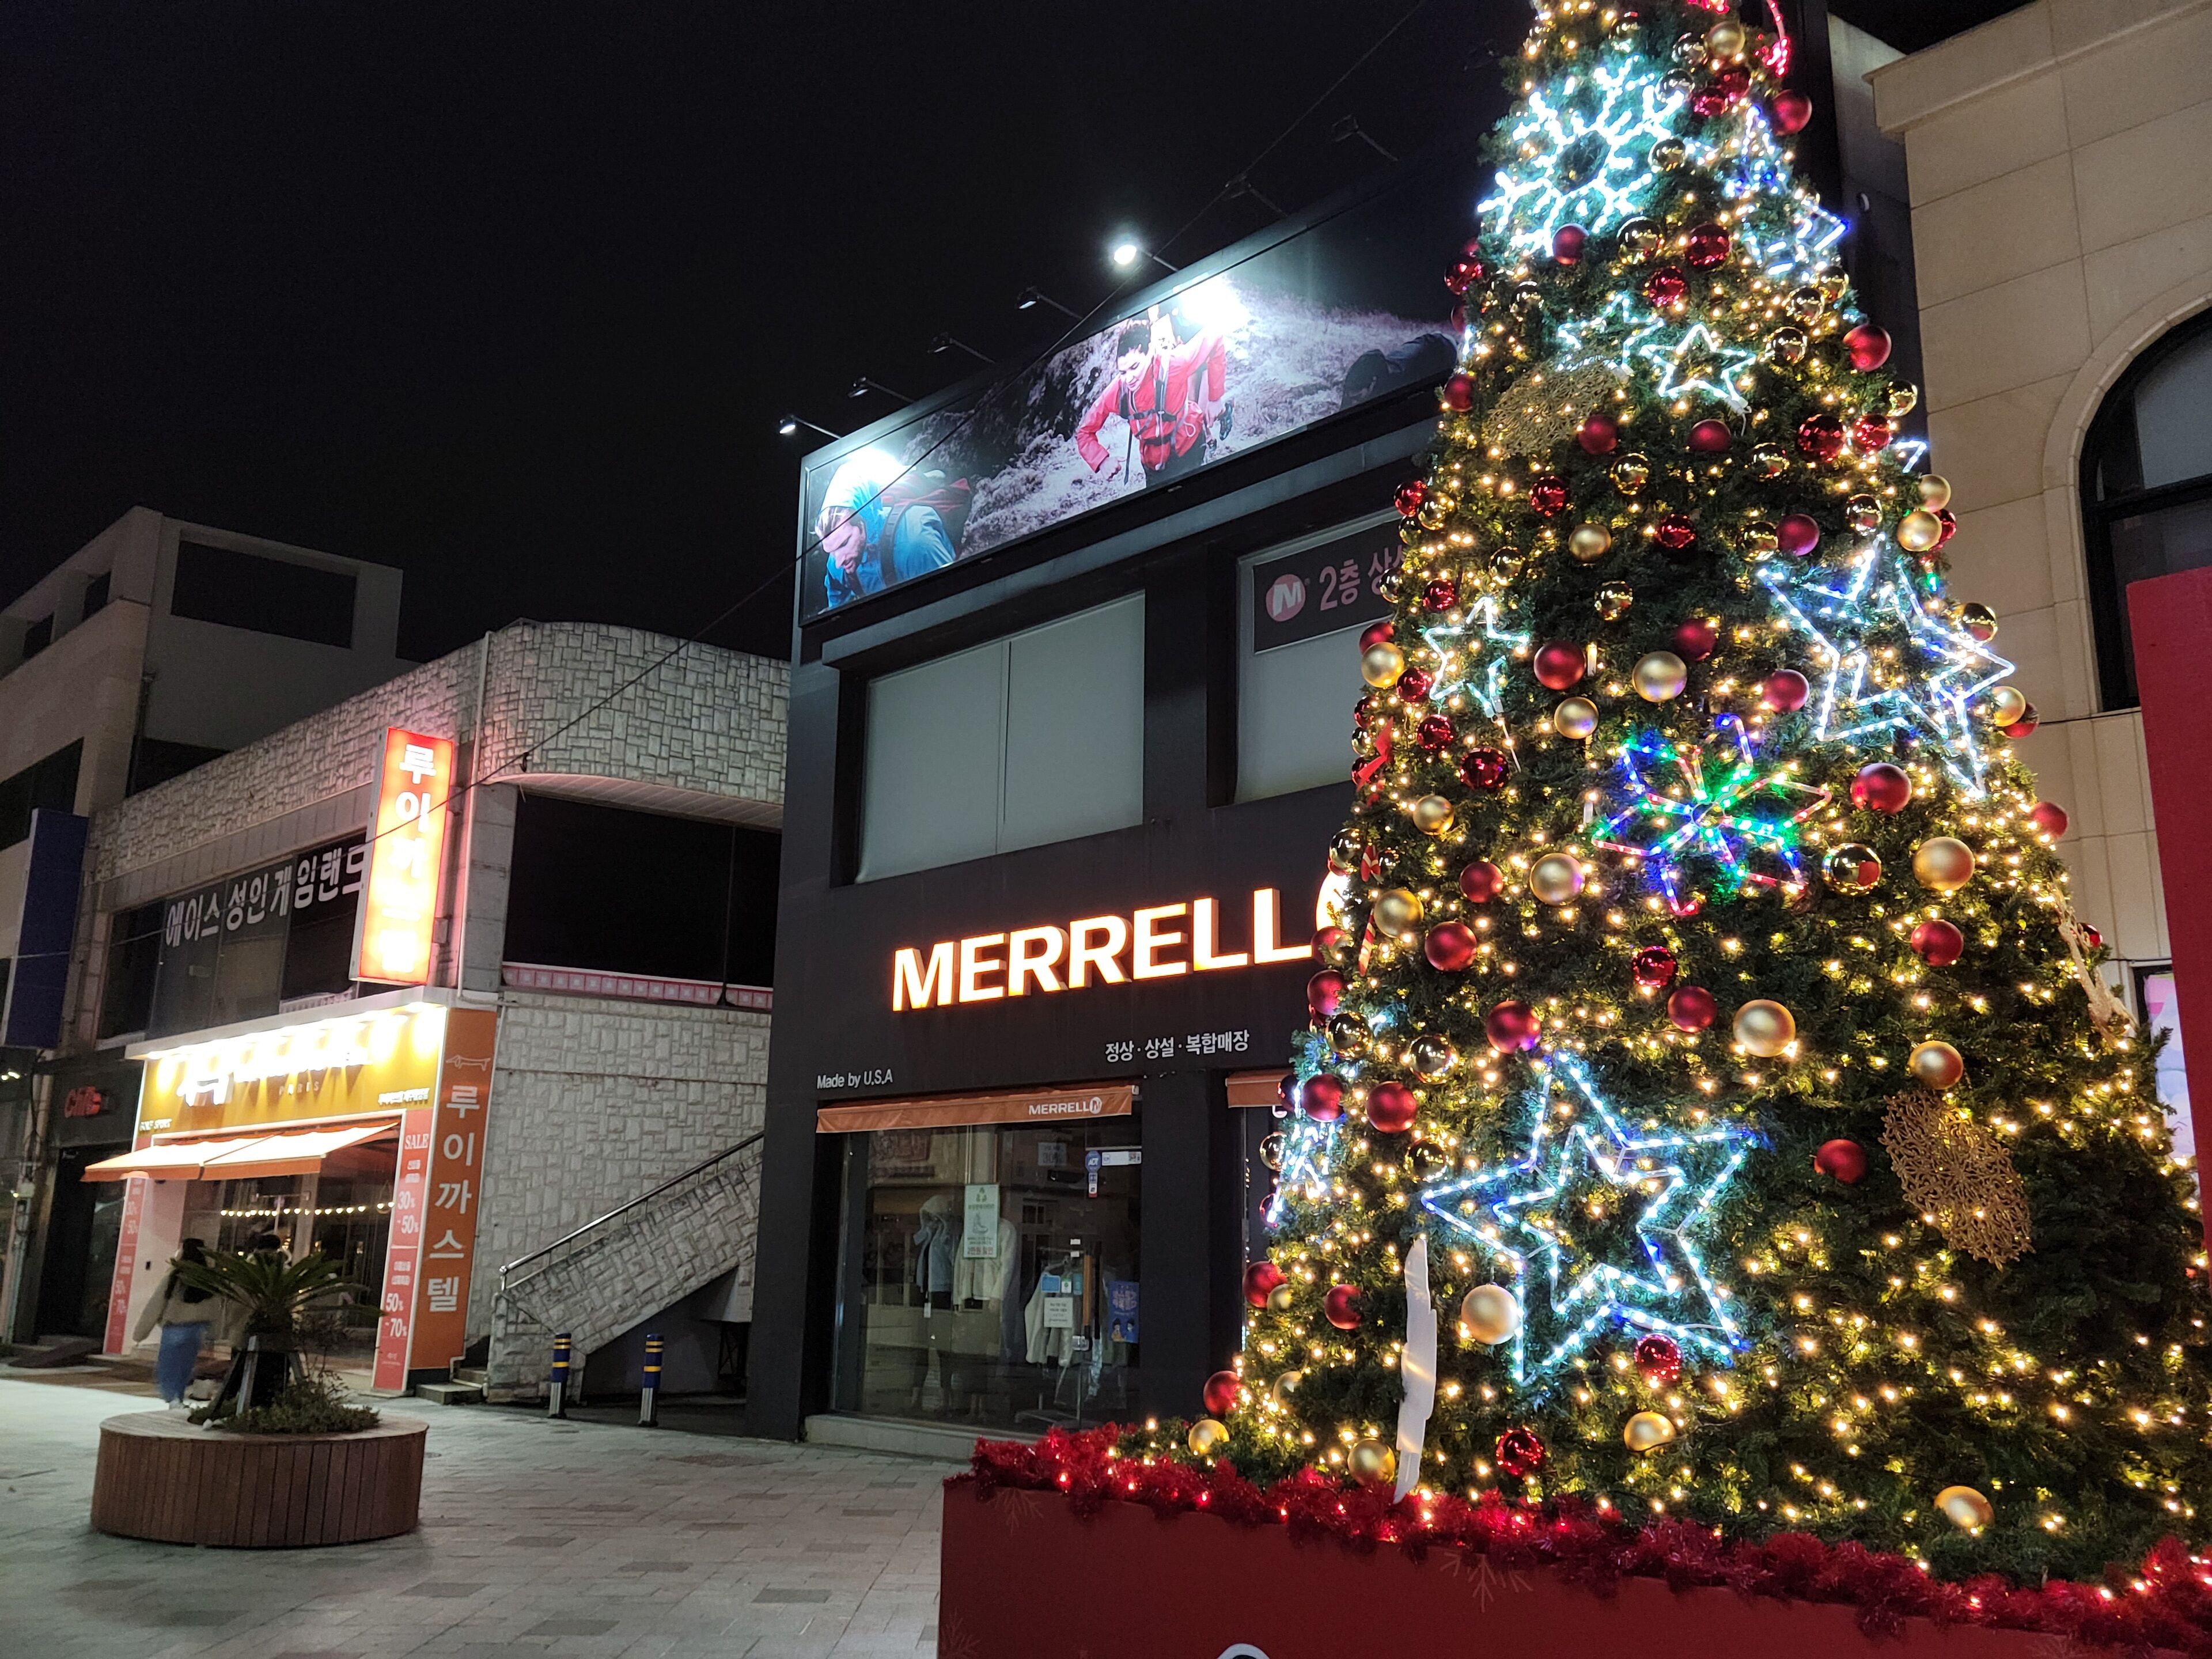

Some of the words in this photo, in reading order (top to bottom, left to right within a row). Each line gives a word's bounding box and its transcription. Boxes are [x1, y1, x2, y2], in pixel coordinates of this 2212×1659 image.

[1319, 558, 1360, 611] 2층
[166, 892, 219, 947] 에이스
[892, 888, 1312, 1012] MERRELL
[817, 1074, 844, 1089] Made
[848, 1072, 861, 1088] by
[863, 1069, 893, 1085] U.S.A
[1029, 1101, 1090, 1115] MERRELL
[404, 1134, 429, 1150] SALE
[1088, 1158, 1099, 1166] ADT
[397, 1191, 415, 1210] 30%
[427, 1085, 480, 1312] 루이까스텔
[386, 1293, 404, 1312] 50%
